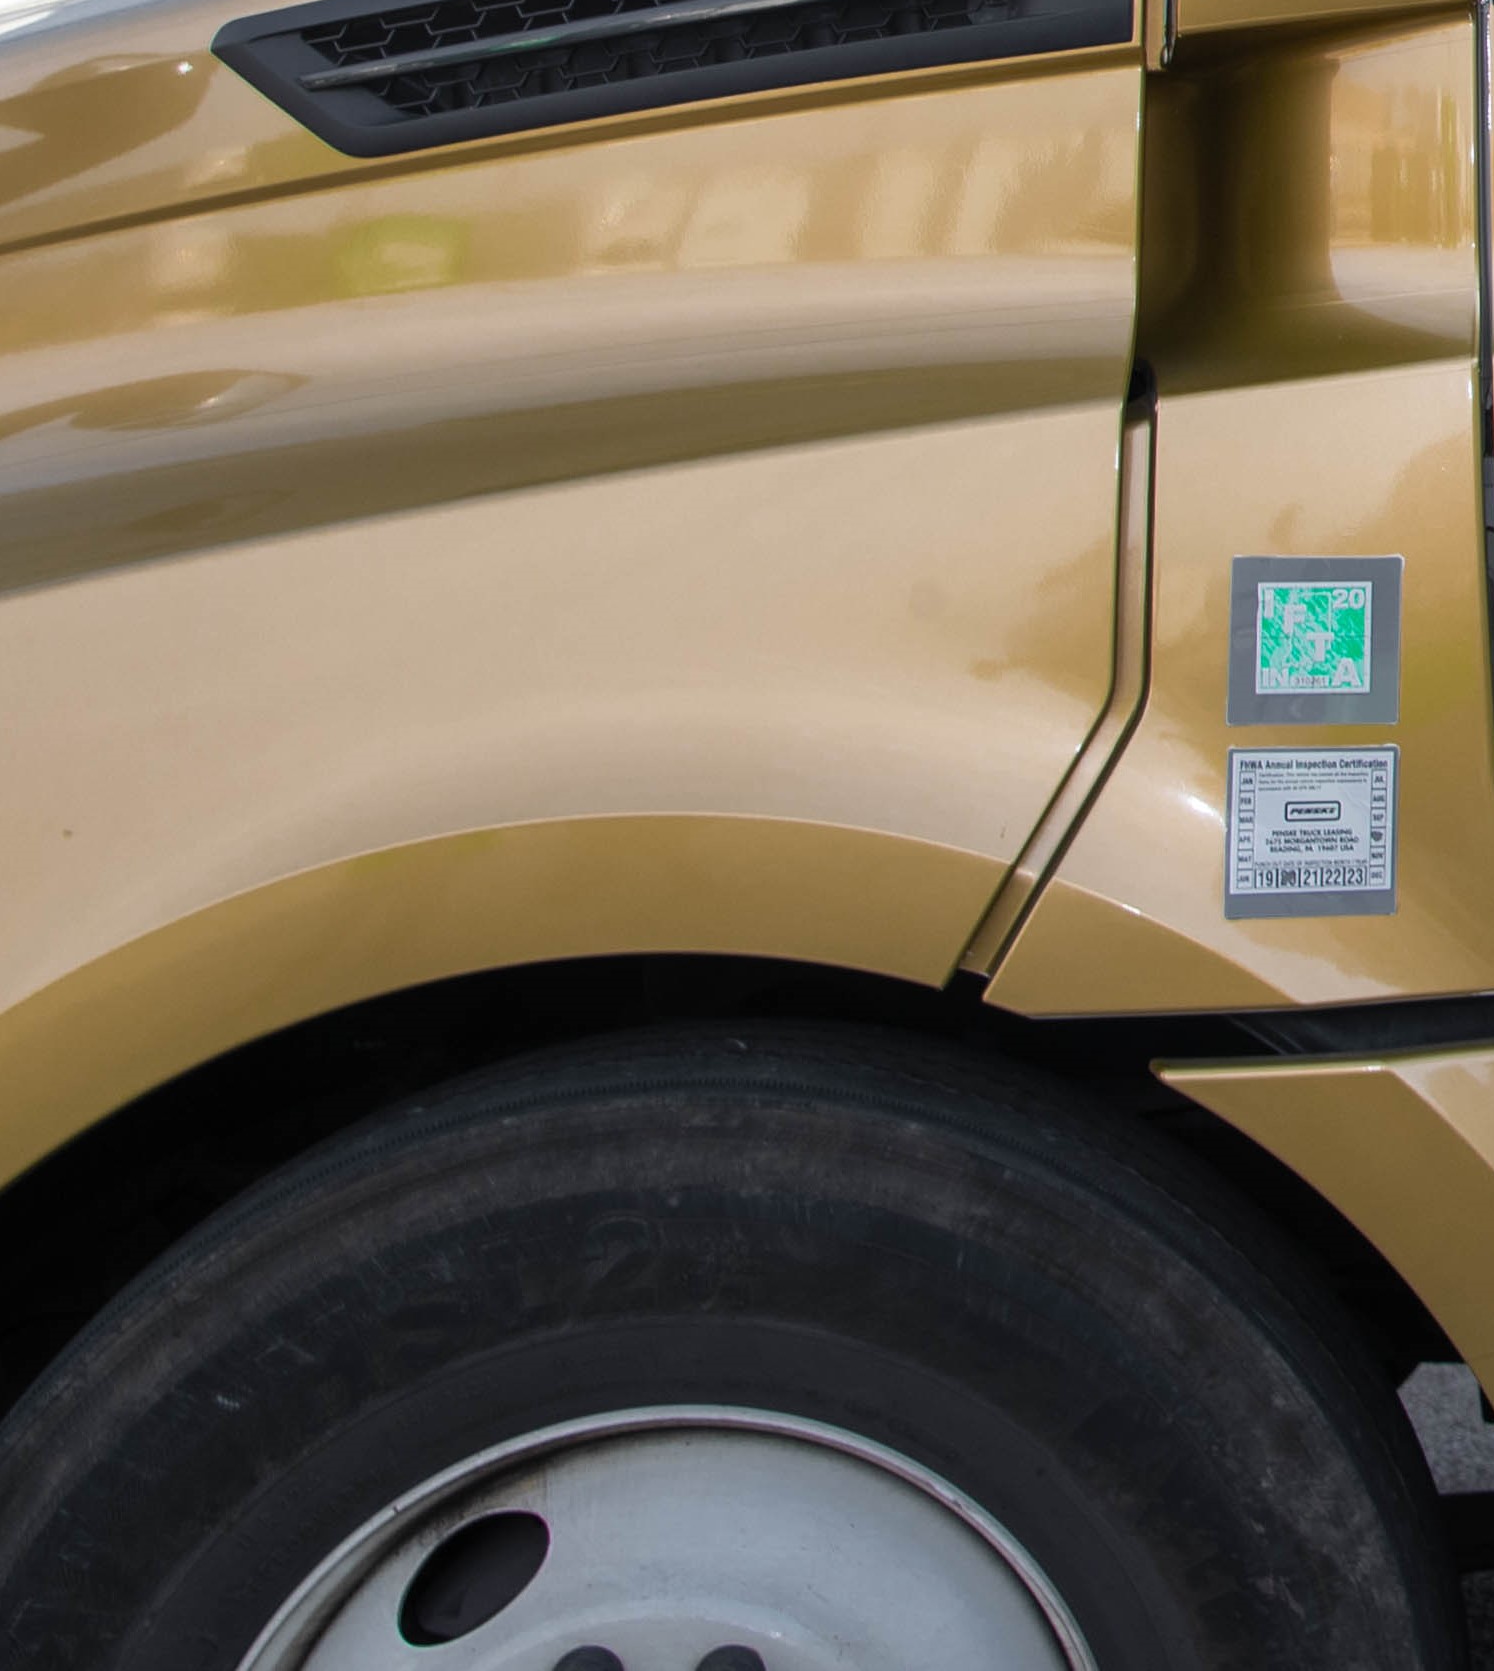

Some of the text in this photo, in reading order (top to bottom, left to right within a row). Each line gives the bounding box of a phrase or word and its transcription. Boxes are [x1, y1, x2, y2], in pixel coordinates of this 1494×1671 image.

[1332, 588, 1365, 609] 20
[1265, 759, 1293, 769] Annual
[1295, 759, 1337, 770] Inspection
[1339, 758, 1388, 768] Certification
[1258, 870, 1274, 887] 19
[1303, 869, 1319, 886] 21
[1325, 869, 1341, 886] 22
[1347, 868, 1364, 885] 23
